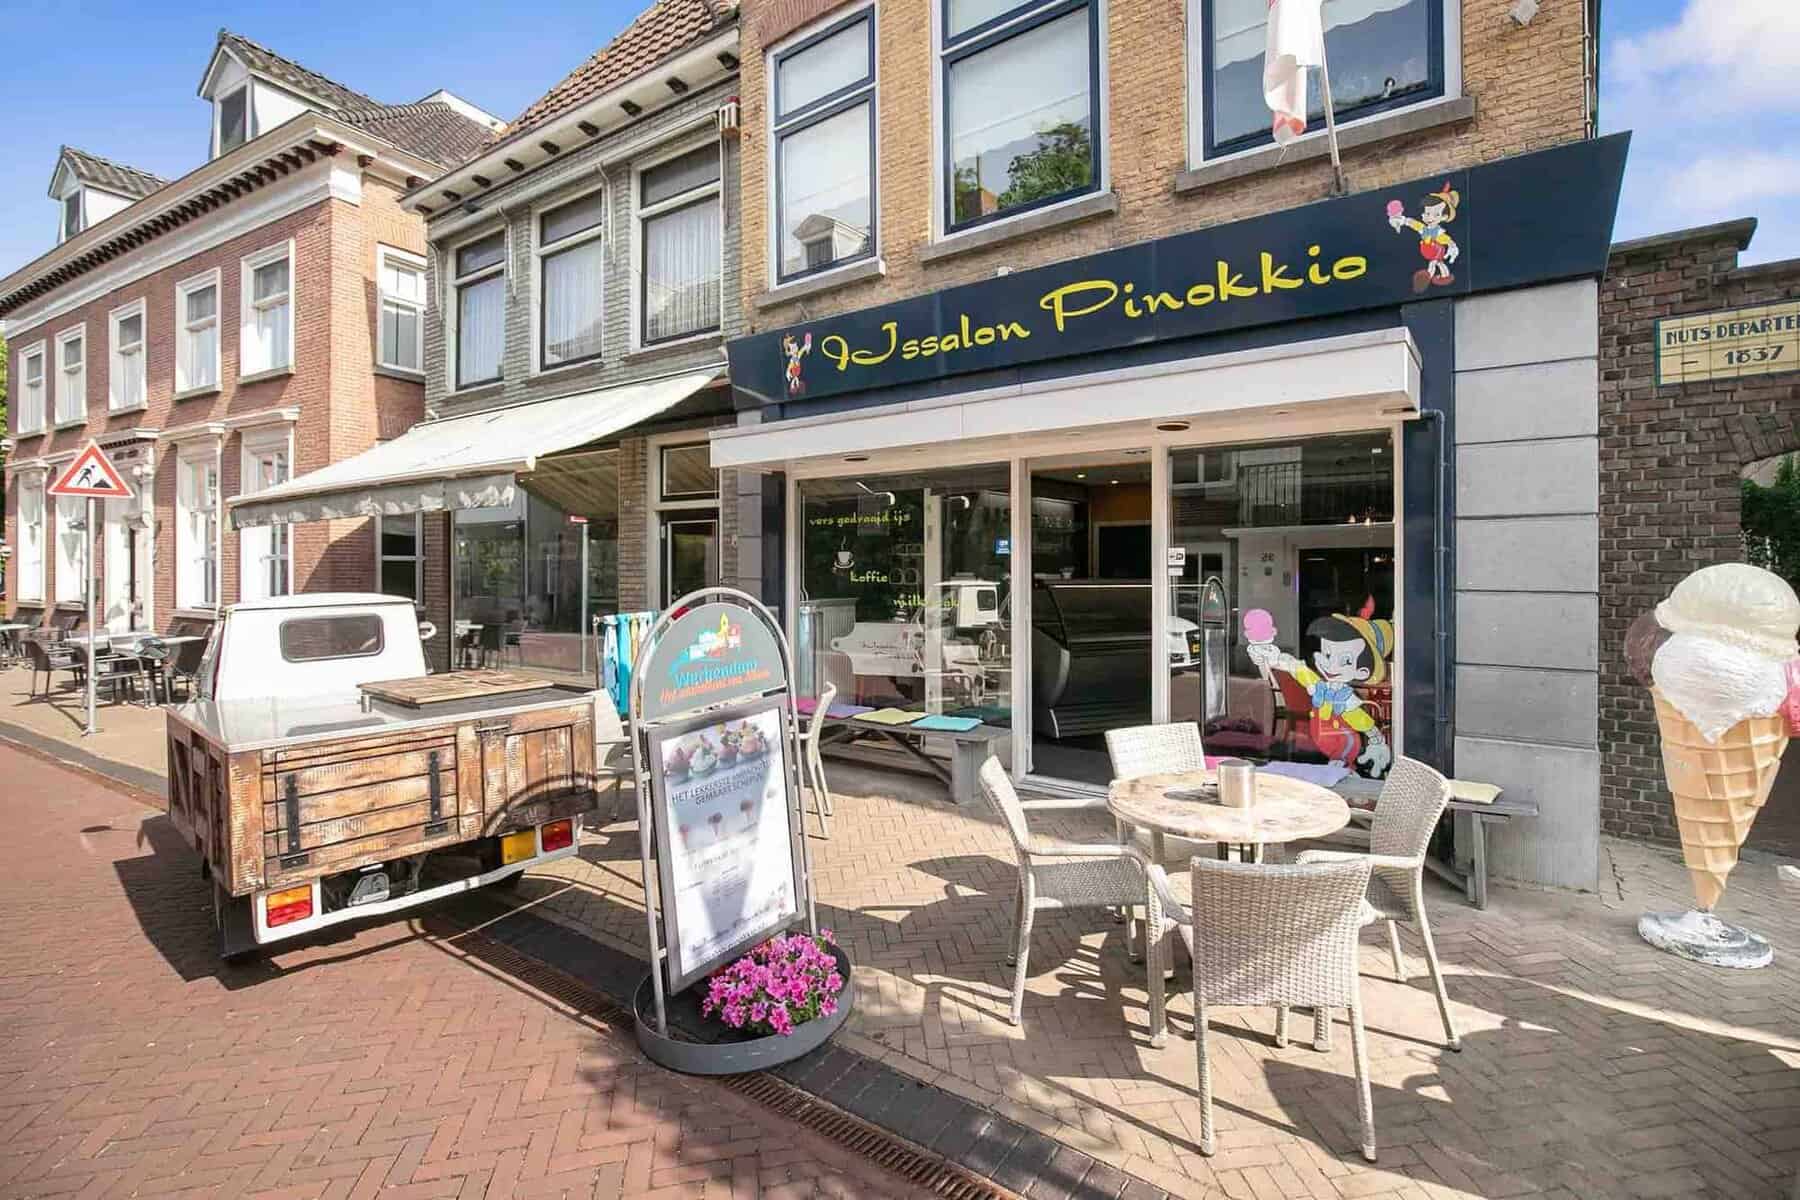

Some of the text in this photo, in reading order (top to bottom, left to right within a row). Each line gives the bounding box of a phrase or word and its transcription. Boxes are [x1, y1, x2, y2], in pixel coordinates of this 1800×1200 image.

[820, 244, 1369, 371] IJssalon Pinokkio
[1665, 326, 1712, 345] NUTS
[849, 570, 889, 583] koffie
